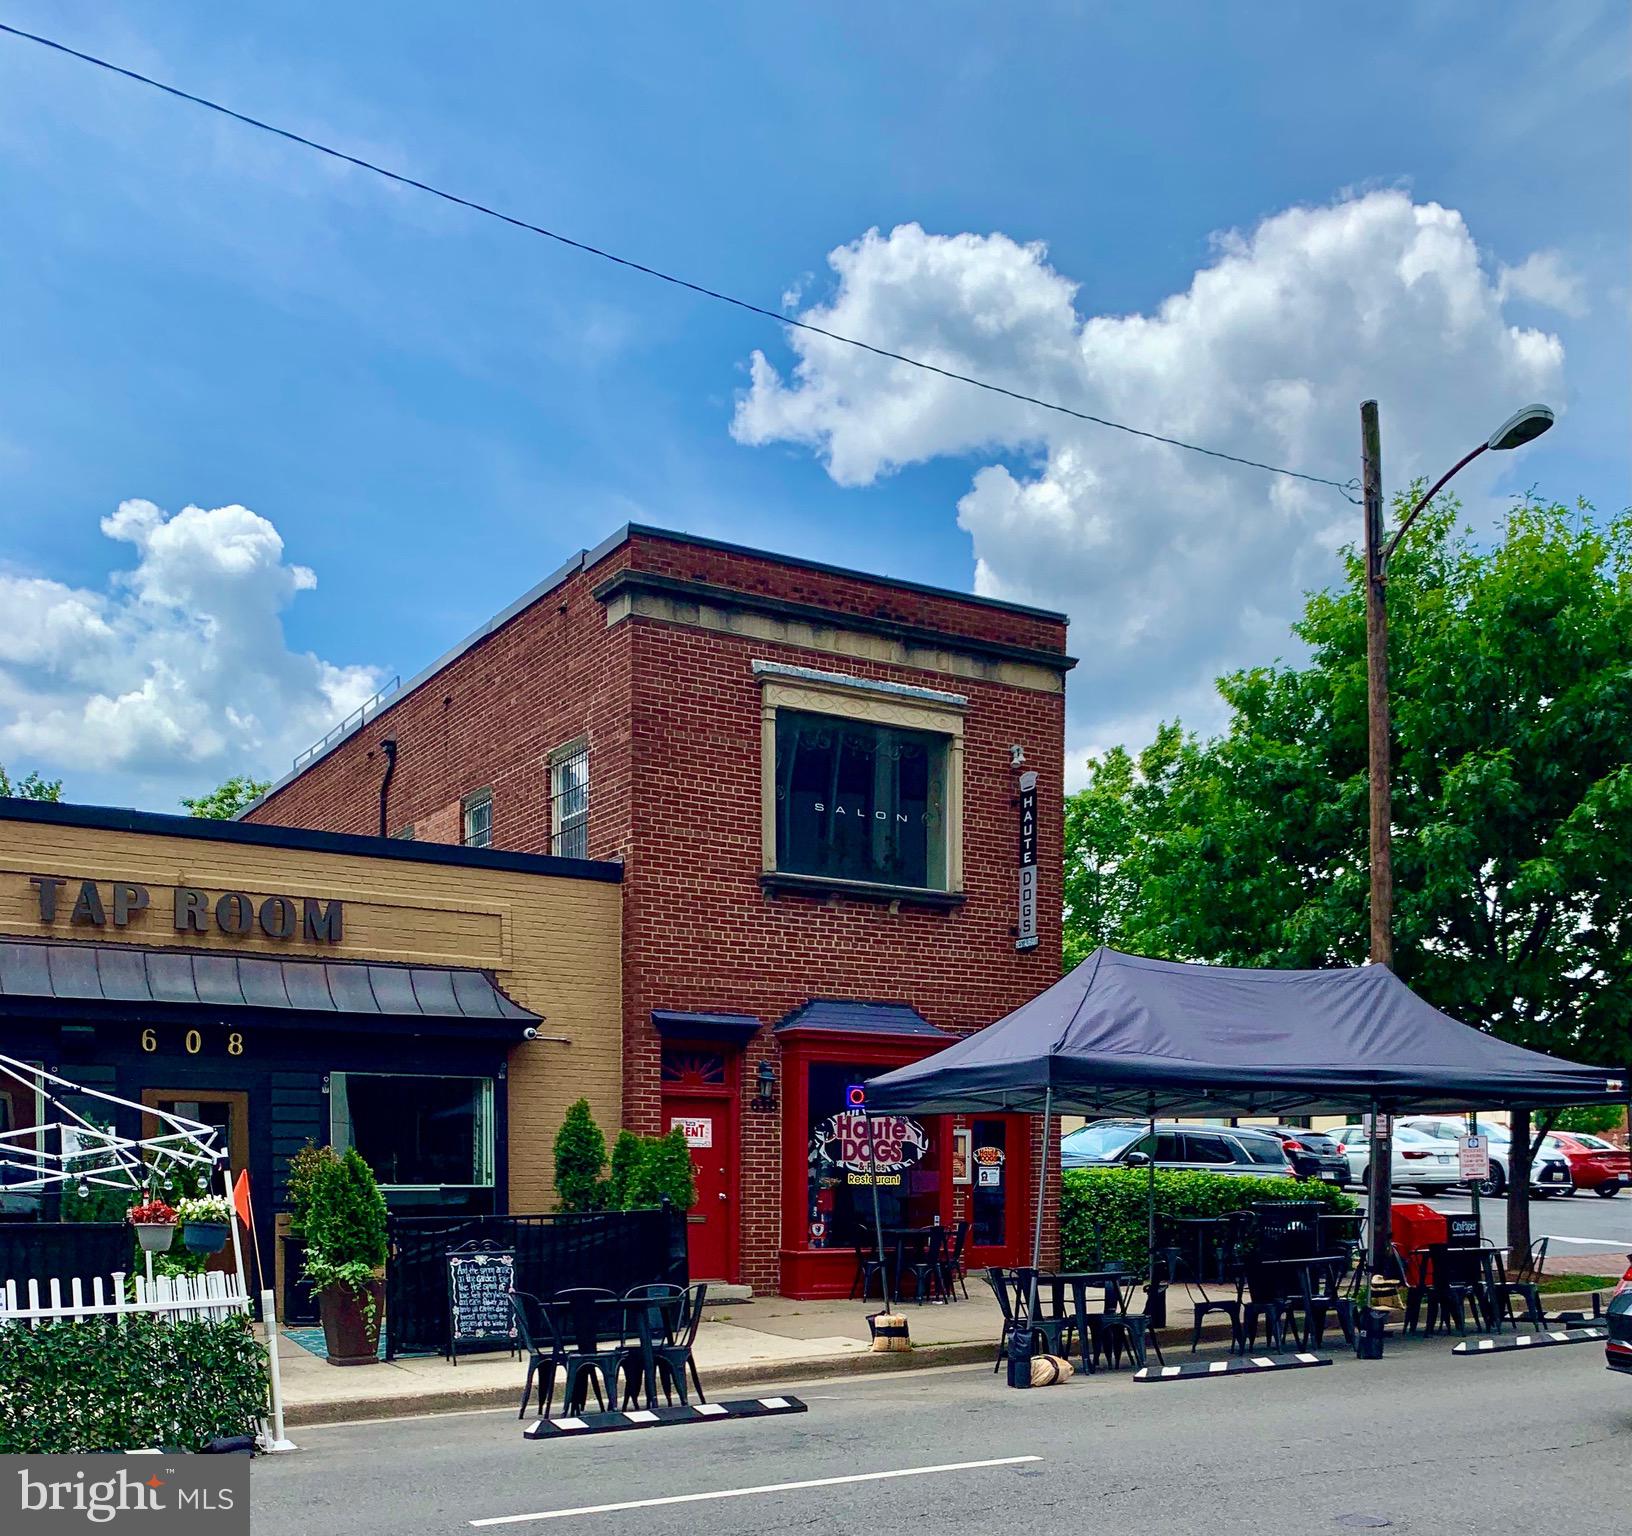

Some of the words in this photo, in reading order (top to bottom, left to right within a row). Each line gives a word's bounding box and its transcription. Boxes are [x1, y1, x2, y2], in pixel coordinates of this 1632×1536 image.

[814, 802, 909, 823] SALON
[1023, 796, 1033, 864] HAUTE
[29, 877, 150, 926] TAP
[174, 886, 344, 942] ROOM
[1022, 871, 1032, 932] DOGS
[141, 1028, 245, 1055] 608
[836, 1115, 907, 1140] Haute
[842, 1140, 902, 1162] DOGS
